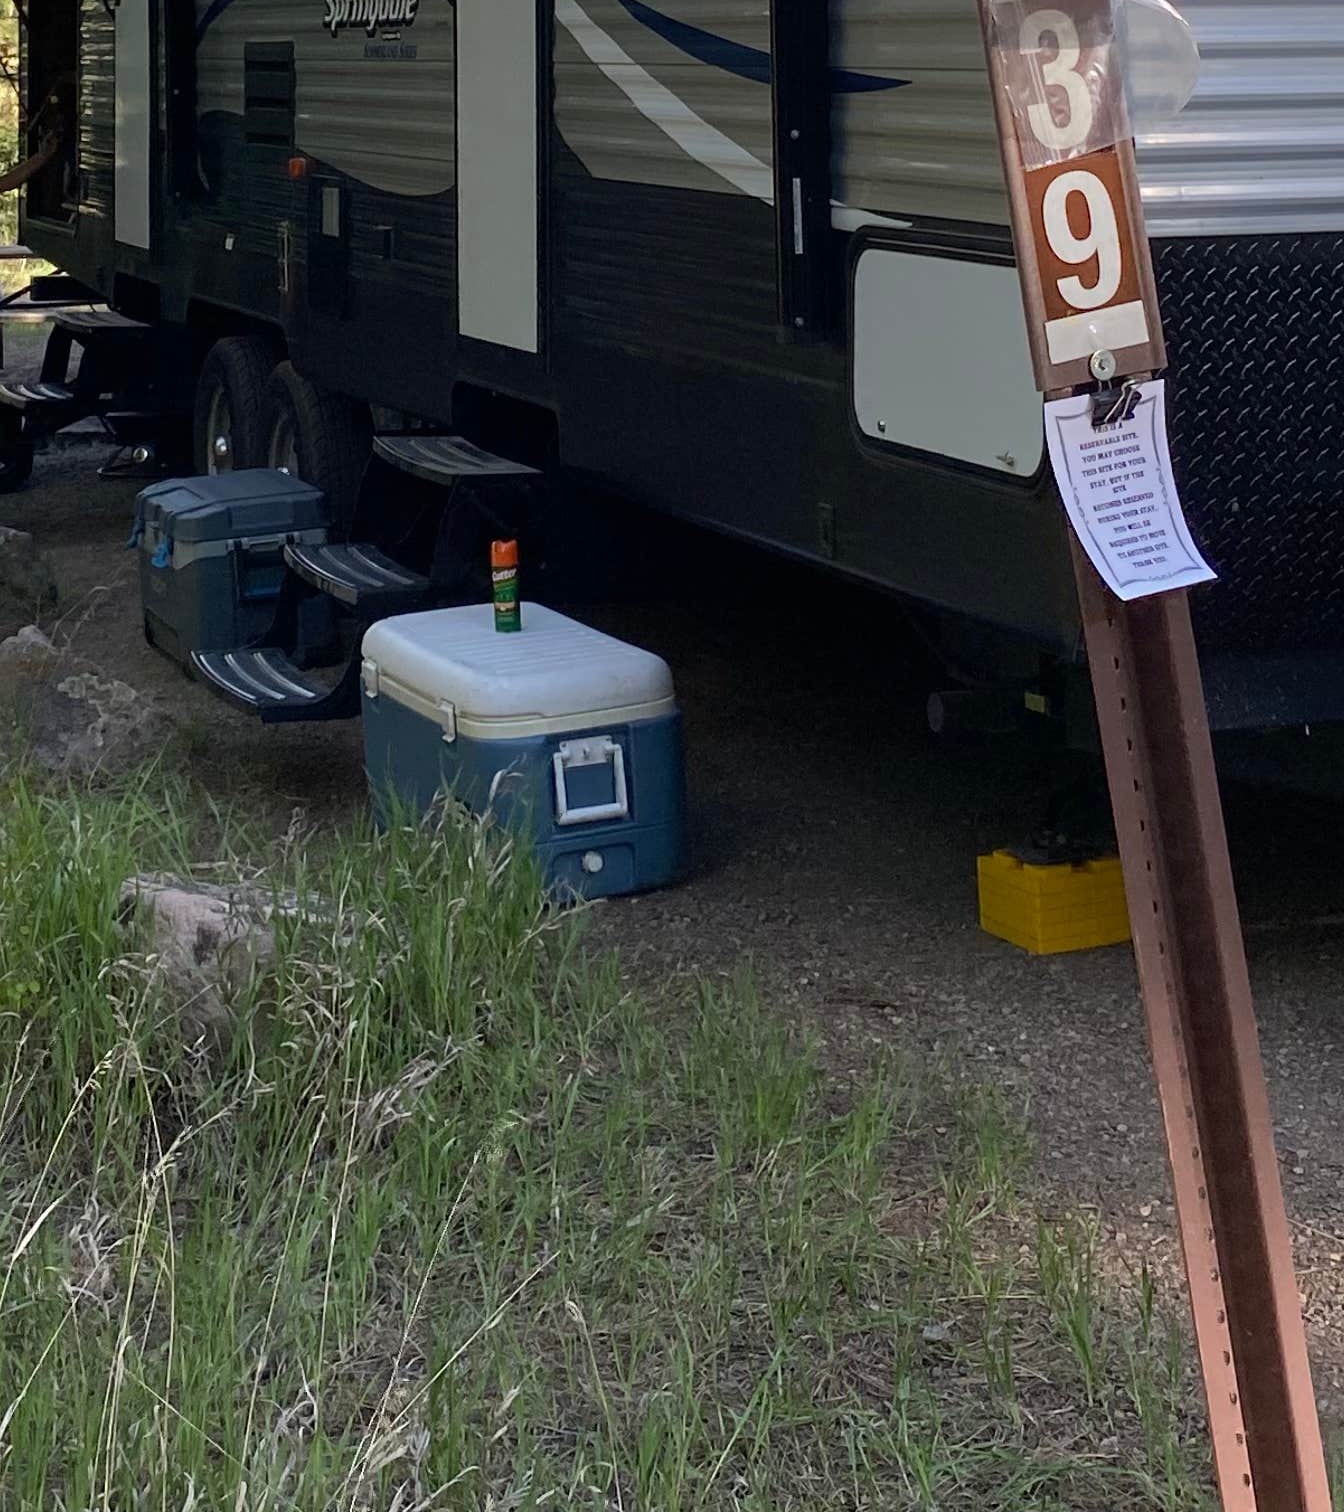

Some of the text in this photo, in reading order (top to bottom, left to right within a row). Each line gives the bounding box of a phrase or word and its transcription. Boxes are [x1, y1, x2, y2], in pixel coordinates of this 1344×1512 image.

[1018, 9, 1094, 150] 3
[1042, 169, 1123, 310] 9
[1082, 454, 1097, 464] YOU
[1098, 450, 1113, 460] MAY
[1082, 468, 1098, 478] THIS
[1114, 461, 1127, 471] FOR
